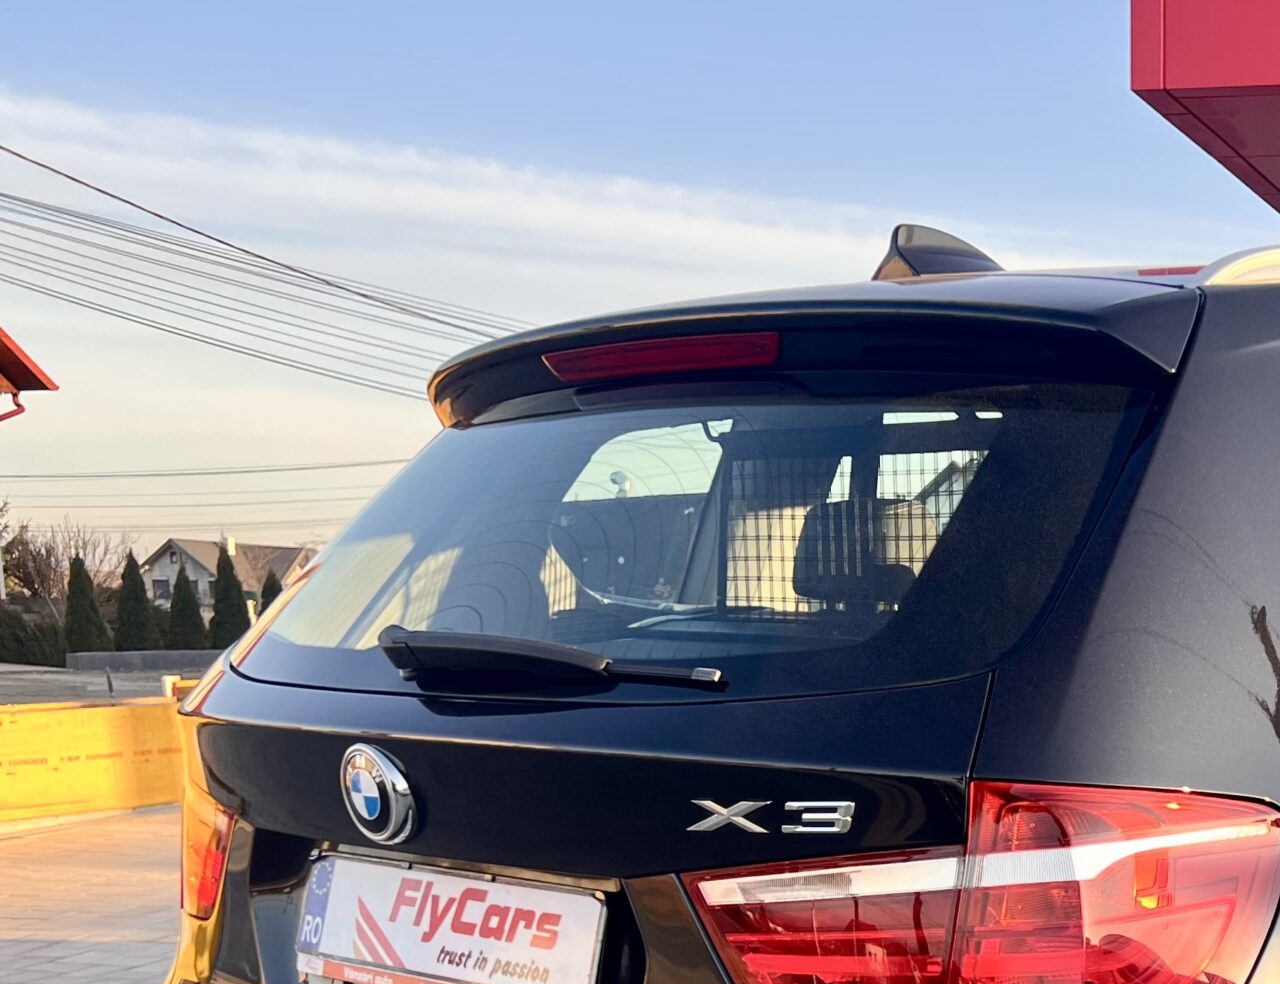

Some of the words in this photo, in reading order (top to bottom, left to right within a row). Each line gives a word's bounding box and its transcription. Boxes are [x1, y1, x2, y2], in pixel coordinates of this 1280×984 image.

[301, 914, 322, 944] RO
[388, 877, 562, 950] FlyCars
[436, 945, 472, 968] trust
[472, 950, 490, 970] in
[489, 958, 551, 984] passion
